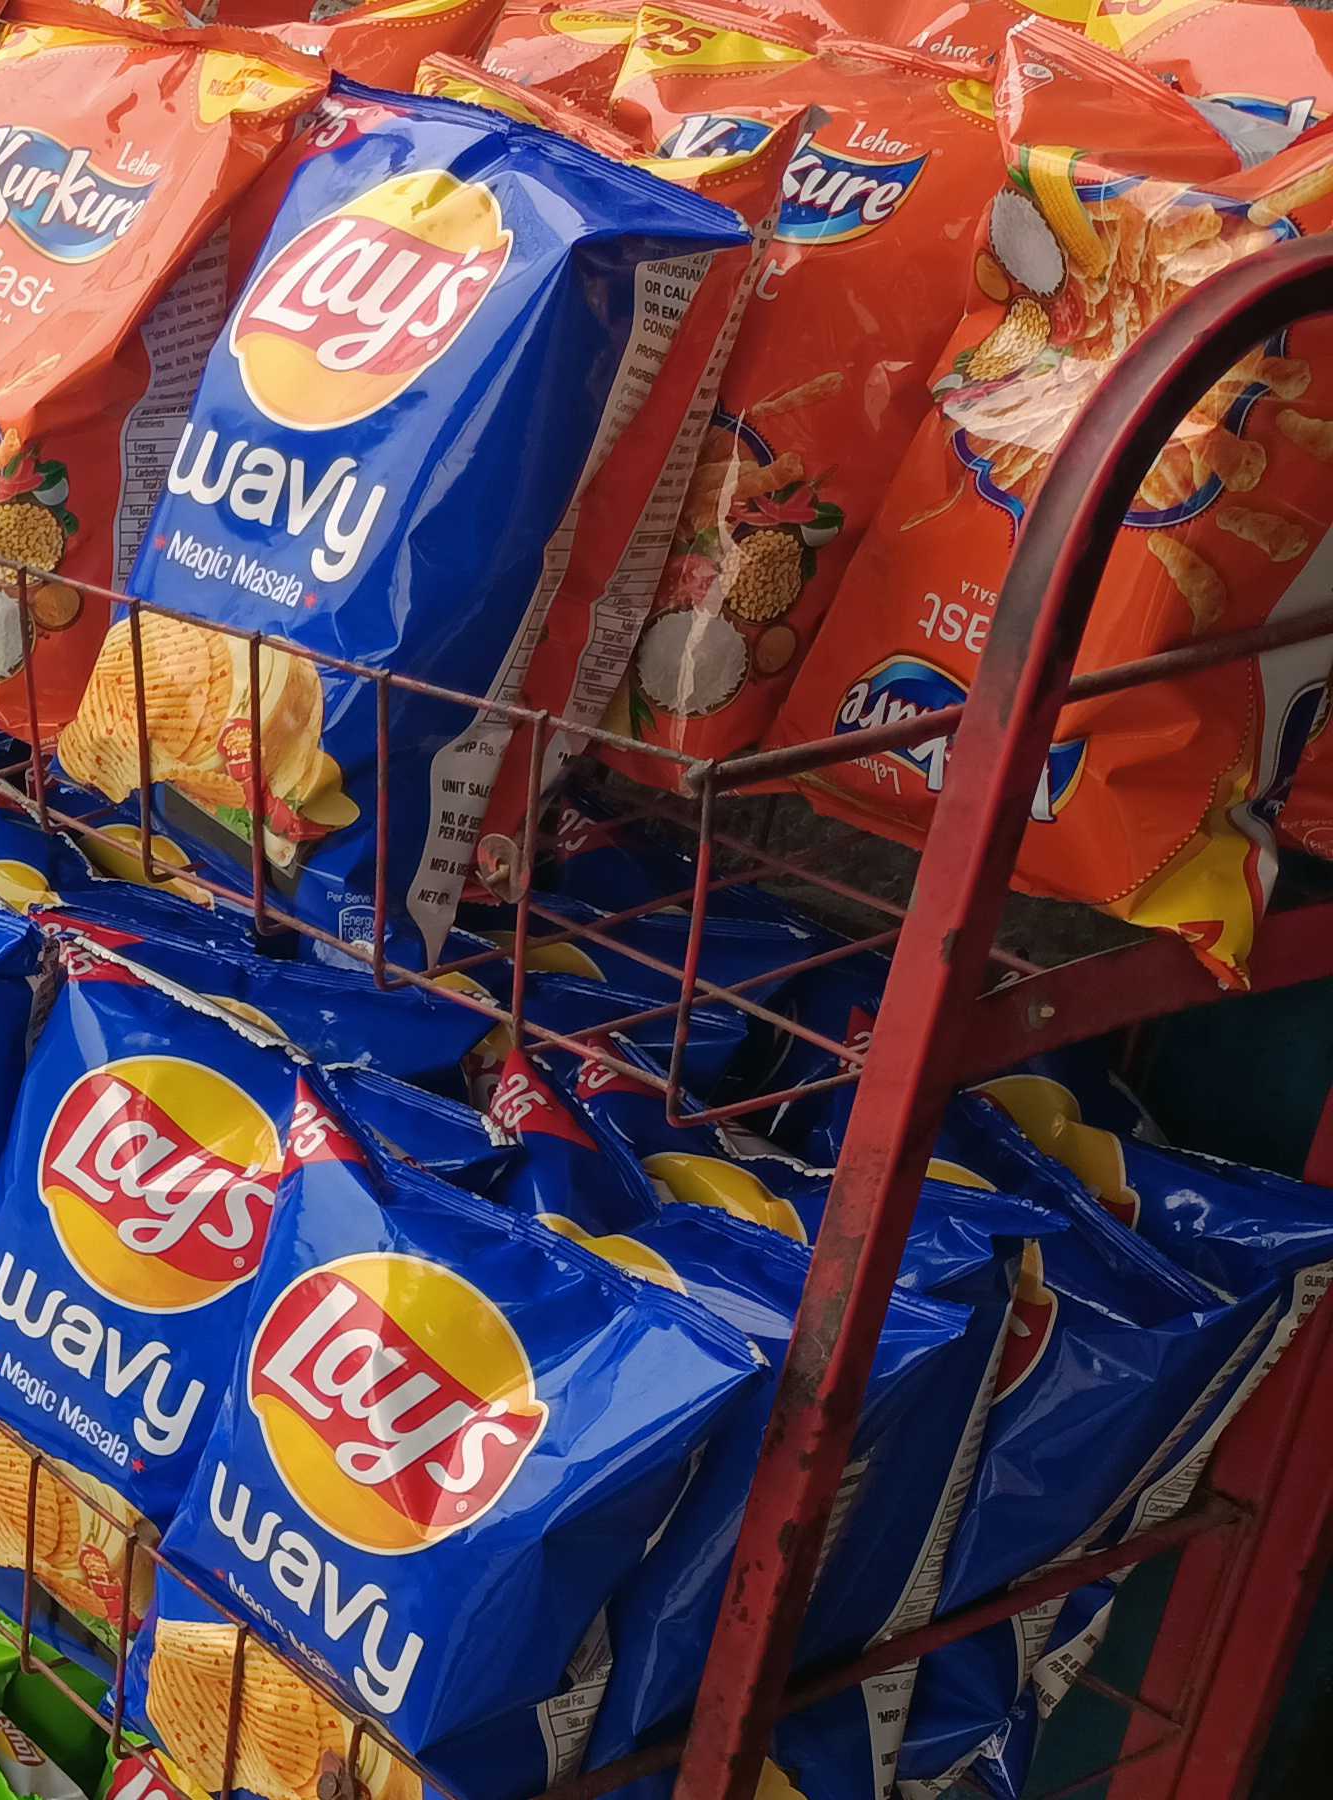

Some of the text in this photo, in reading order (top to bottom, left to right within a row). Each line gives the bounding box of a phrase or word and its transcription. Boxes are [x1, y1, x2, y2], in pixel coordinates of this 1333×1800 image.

[846, 121, 911, 156] Lehar
[116, 141, 162, 177] Lehar
[252, 219, 489, 372] Lay's
[645, 279, 661, 295] OR
[644, 301, 660, 315] OR
[166, 421, 385, 582] wavy
[165, 535, 304, 608] Magic Masala
[960, 580, 998, 606] SALA
[918, 593, 991, 653] ast
[442, 779, 465, 795] UNIT
[438, 826, 454, 841] PER
[441, 811, 456, 826] NO.
[326, 891, 343, 902] Per
[52, 1081, 276, 1254] Lay's
[261, 1281, 518, 1494] Lay's
[0, 1352, 131, 1467] Magic Masala
[209, 1461, 424, 1714] wavy
